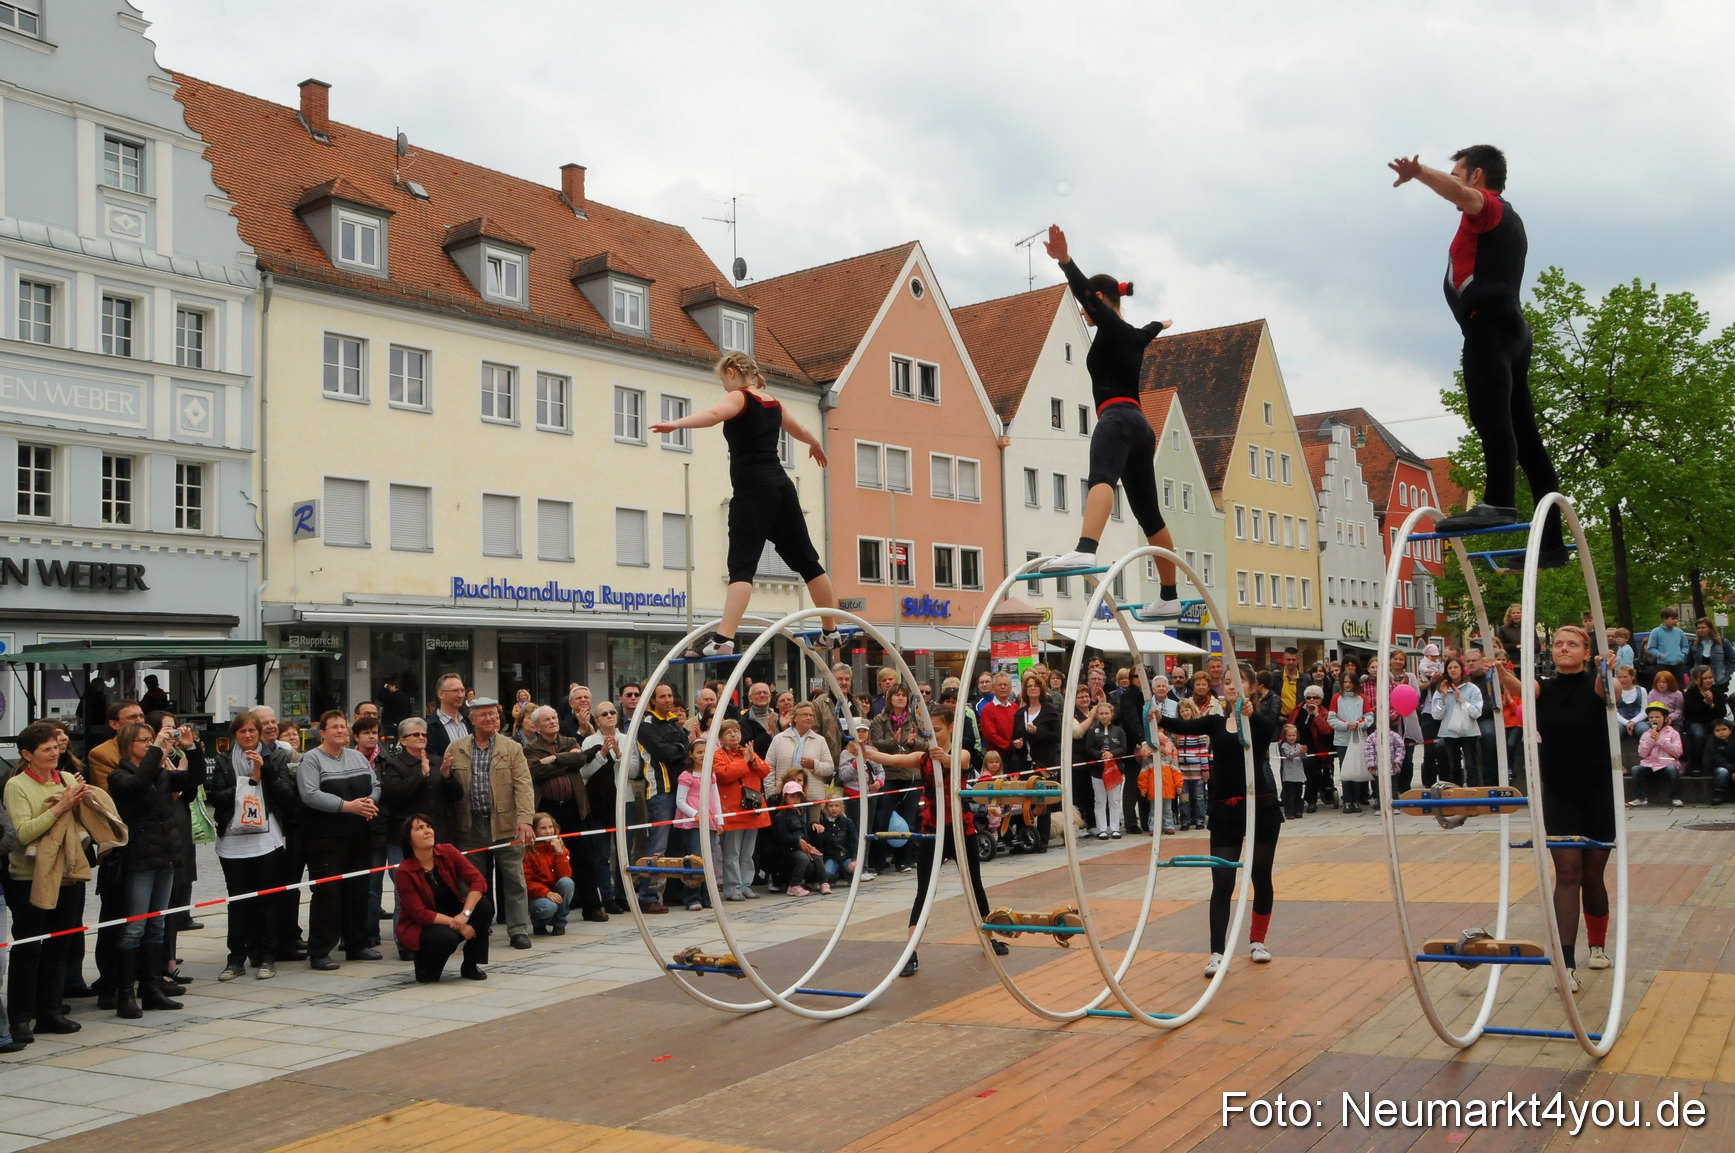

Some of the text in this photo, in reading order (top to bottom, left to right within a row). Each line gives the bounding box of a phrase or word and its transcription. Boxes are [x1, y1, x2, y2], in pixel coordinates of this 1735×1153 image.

[42, 380, 135, 416] WEBER
[0, 556, 151, 592] N WEBER
[450, 576, 687, 611] Buchhandlung Rupprecht
[300, 635, 339, 648] Rupprecht
[435, 638, 470, 650] Rupprecht
[247, 807, 258, 818] M
